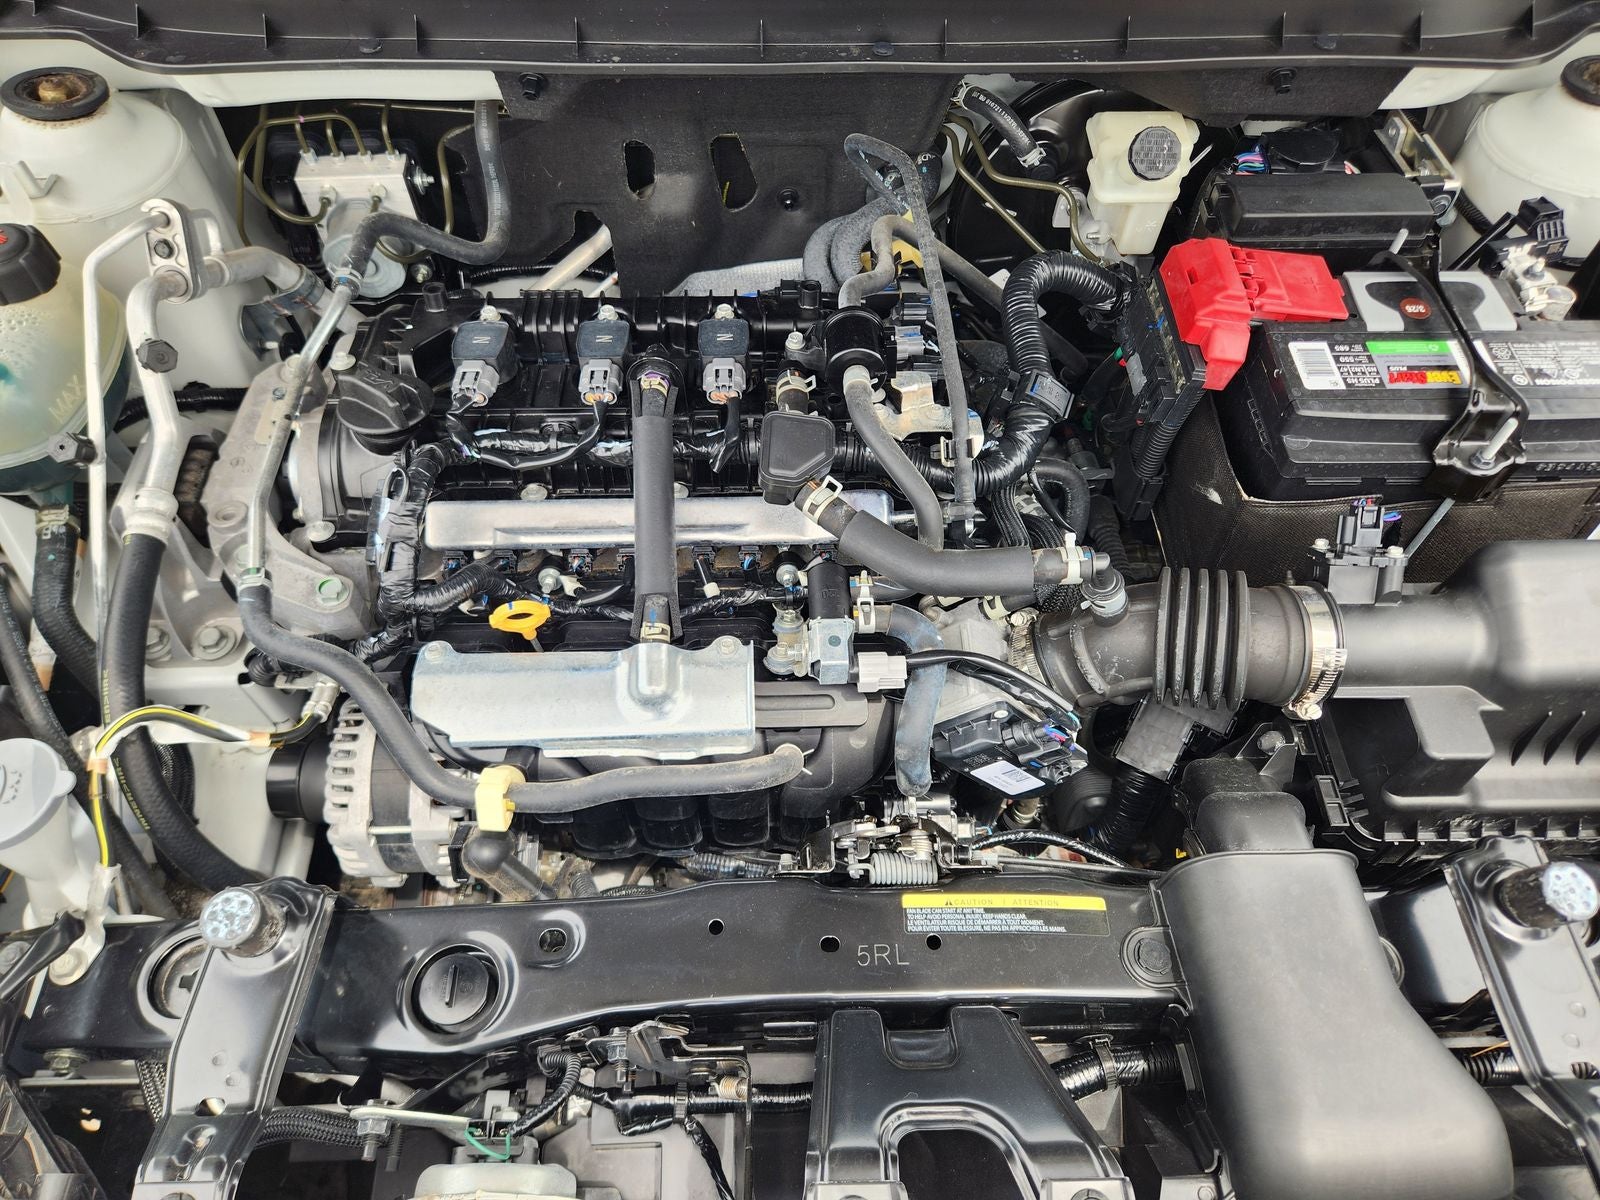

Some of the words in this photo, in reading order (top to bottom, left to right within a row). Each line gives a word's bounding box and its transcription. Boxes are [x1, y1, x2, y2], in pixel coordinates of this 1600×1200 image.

[1388, 371, 1462, 384] EverStart
[48, 374, 81, 425] MAX
[1012, 899, 1060, 907] ATTENTION
[857, 944, 910, 966] 5RL
